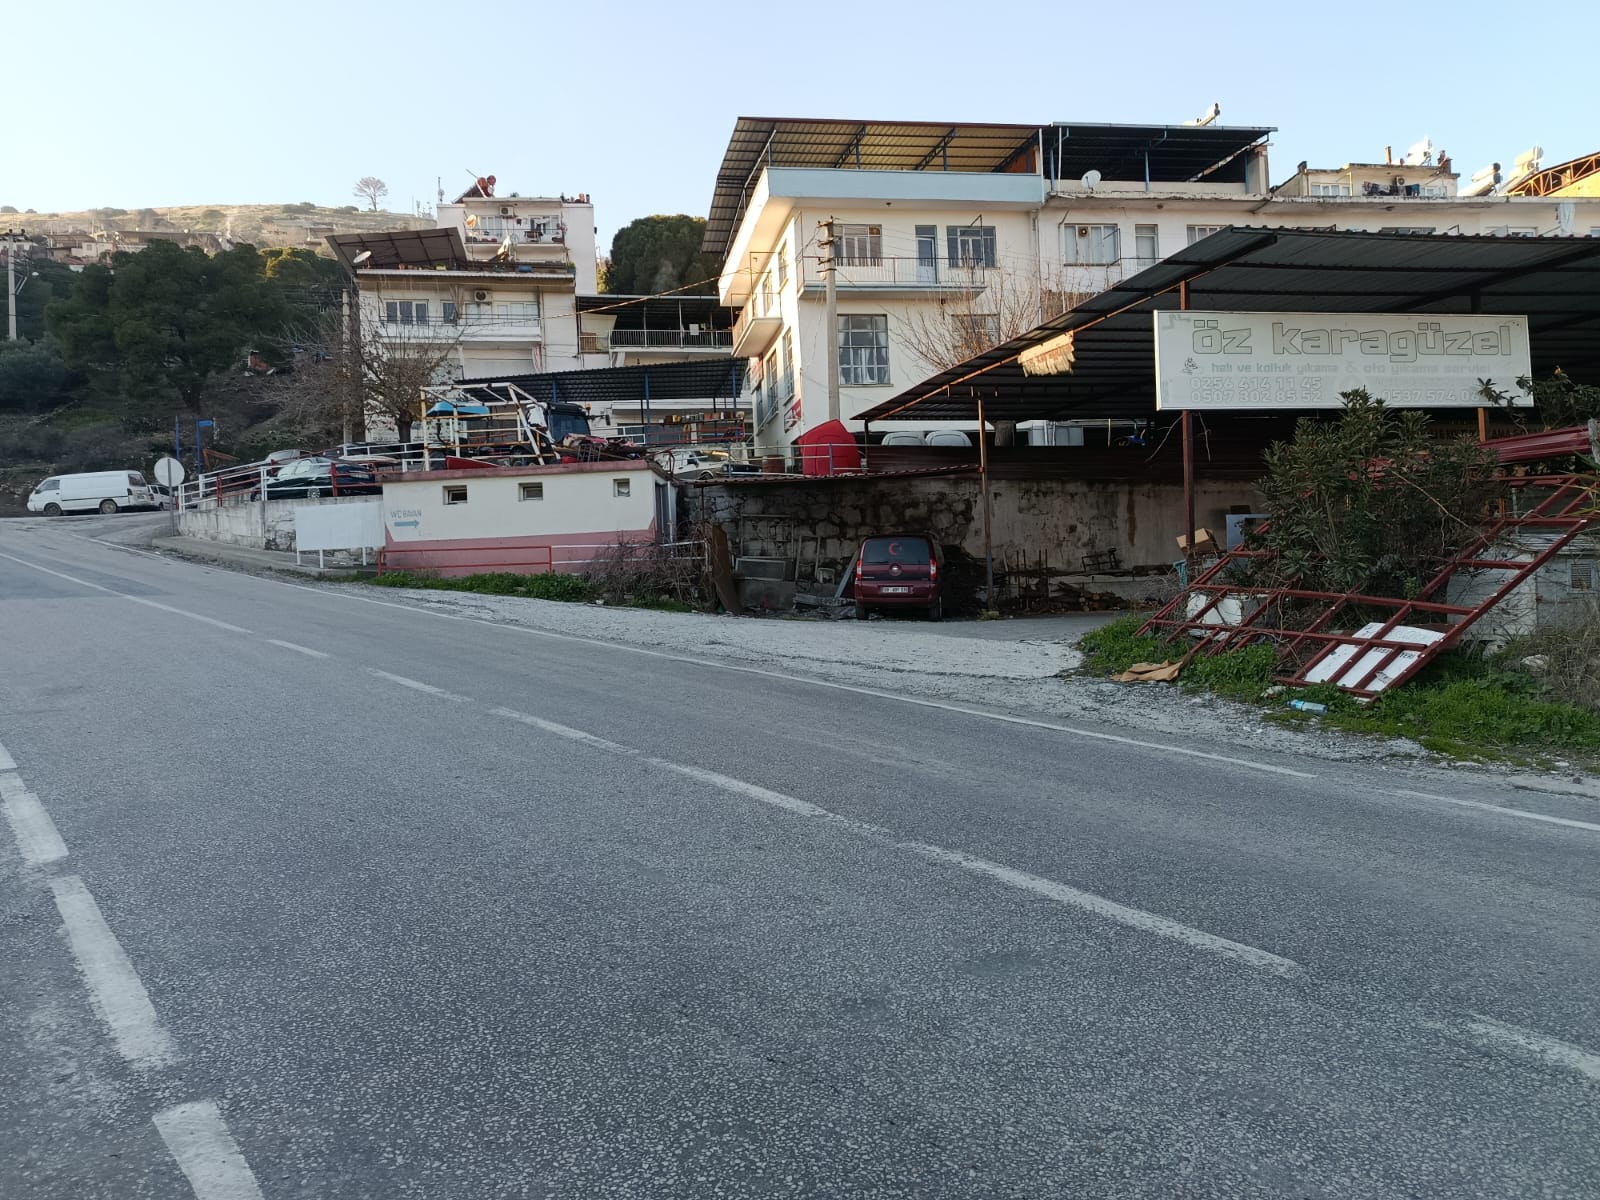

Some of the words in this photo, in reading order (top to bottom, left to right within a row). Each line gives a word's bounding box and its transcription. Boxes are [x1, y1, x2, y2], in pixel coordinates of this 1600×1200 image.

[1192, 319, 1253, 355] öz
[1271, 322, 1512, 363] karagüzel
[1237, 364, 1252, 373] ve
[1256, 362, 1292, 373] koltuk
[1190, 376, 1234, 389] 0256
[1239, 376, 1272, 389] 414
[1275, 376, 1296, 389] 11
[1301, 376, 1322, 389] 45
[1190, 390, 1234, 403] 0507
[1239, 390, 1272, 403] 302
[1275, 390, 1296, 403] 85
[1301, 390, 1322, 403] 52
[1383, 388, 1423, 402] 0537
[1426, 388, 1457, 402] 574
[390, 510, 402, 519] WC
